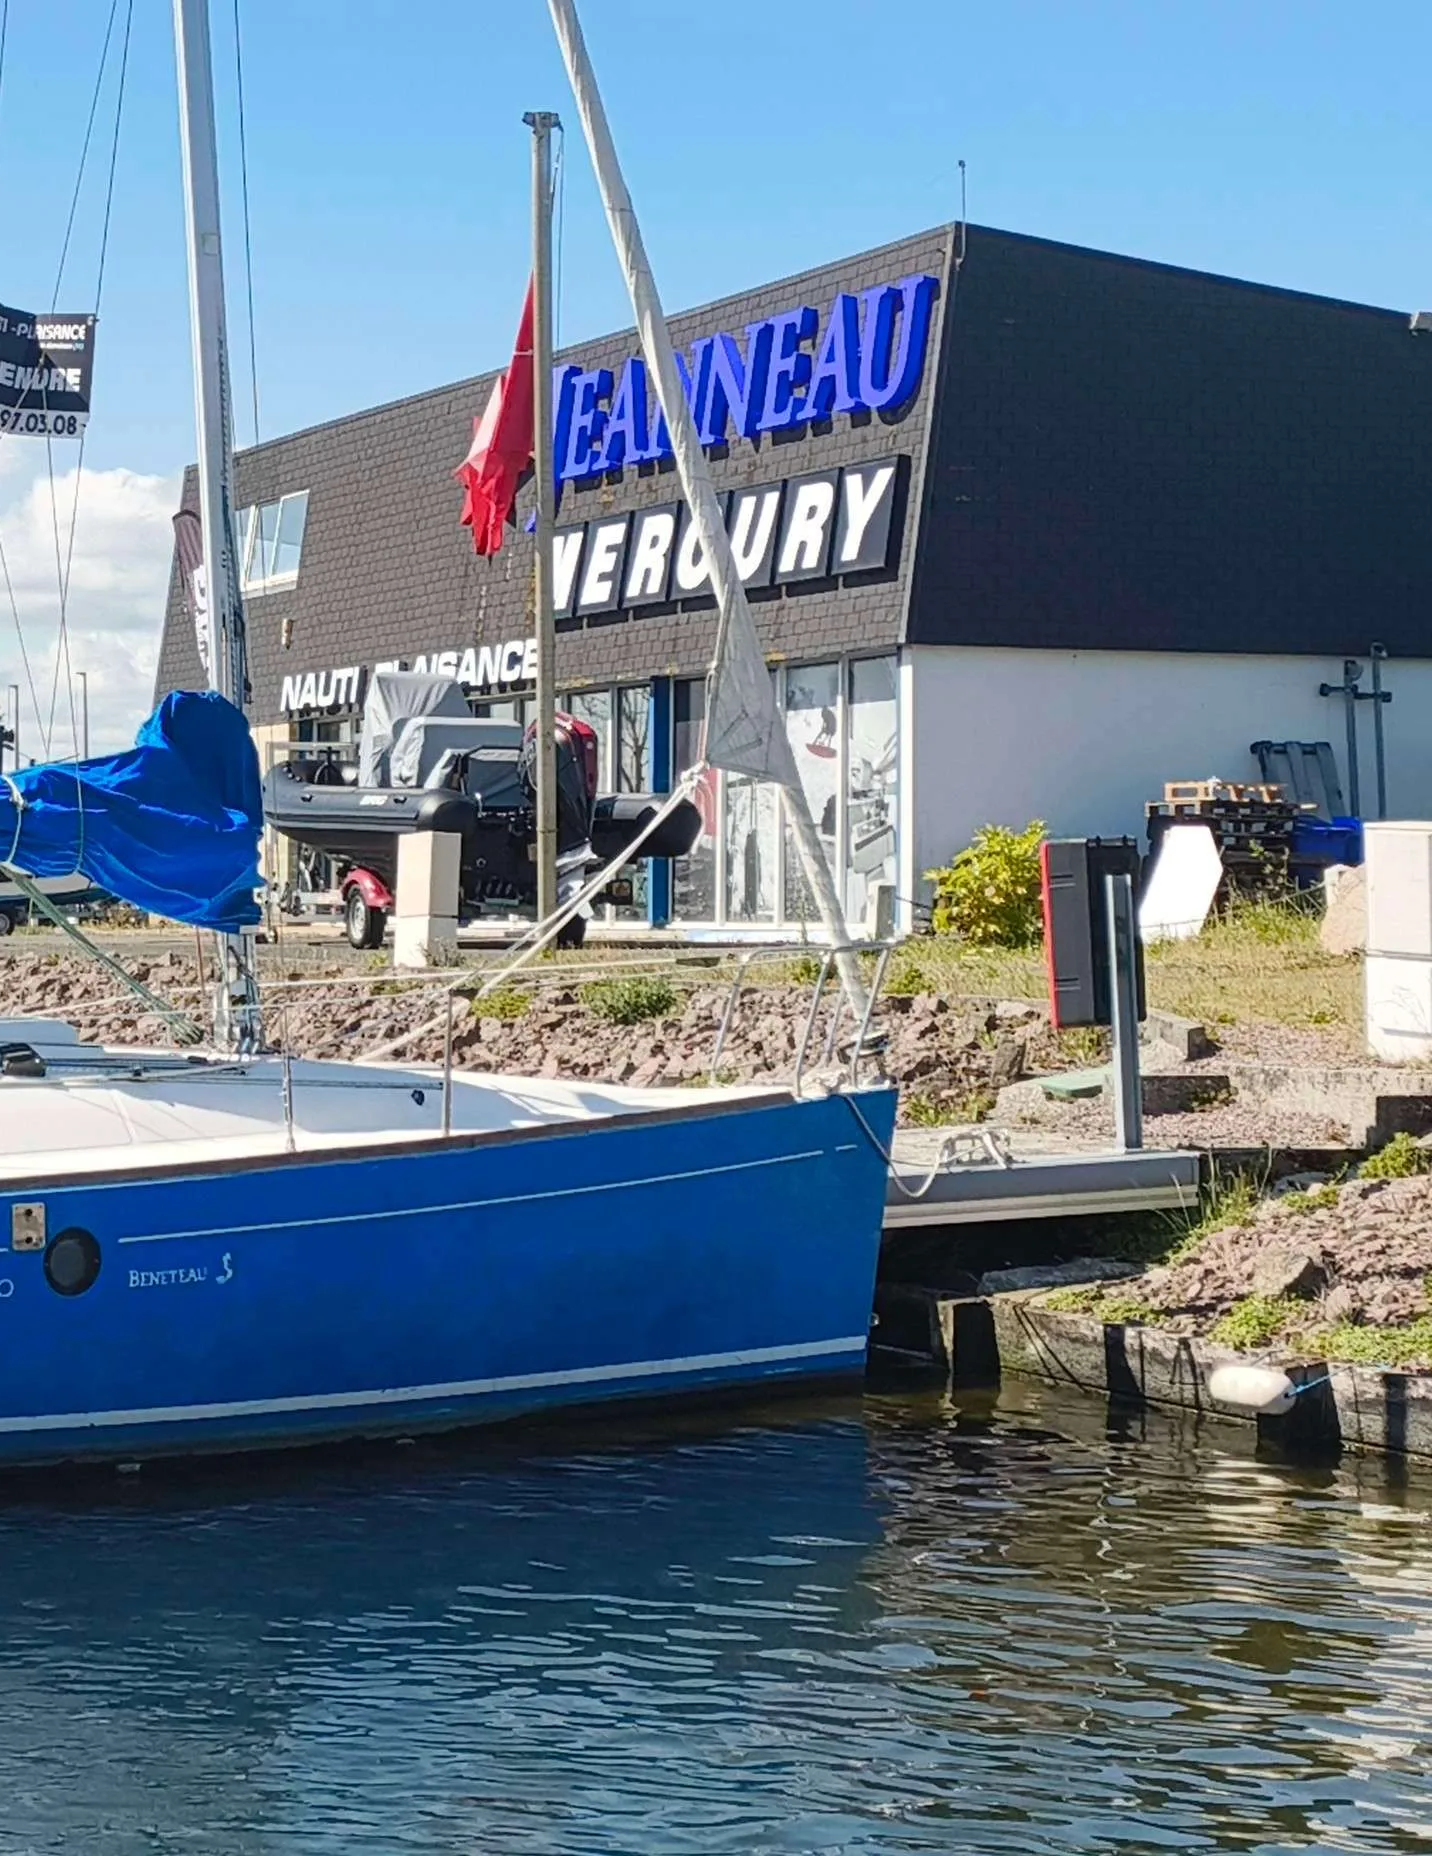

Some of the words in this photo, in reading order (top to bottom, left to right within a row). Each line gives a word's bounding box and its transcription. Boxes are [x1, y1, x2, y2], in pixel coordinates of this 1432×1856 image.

[553, 467, 896, 610] MERCURY
[280, 666, 360, 712] NAUTI
[375, 639, 538, 686] AISANCE
